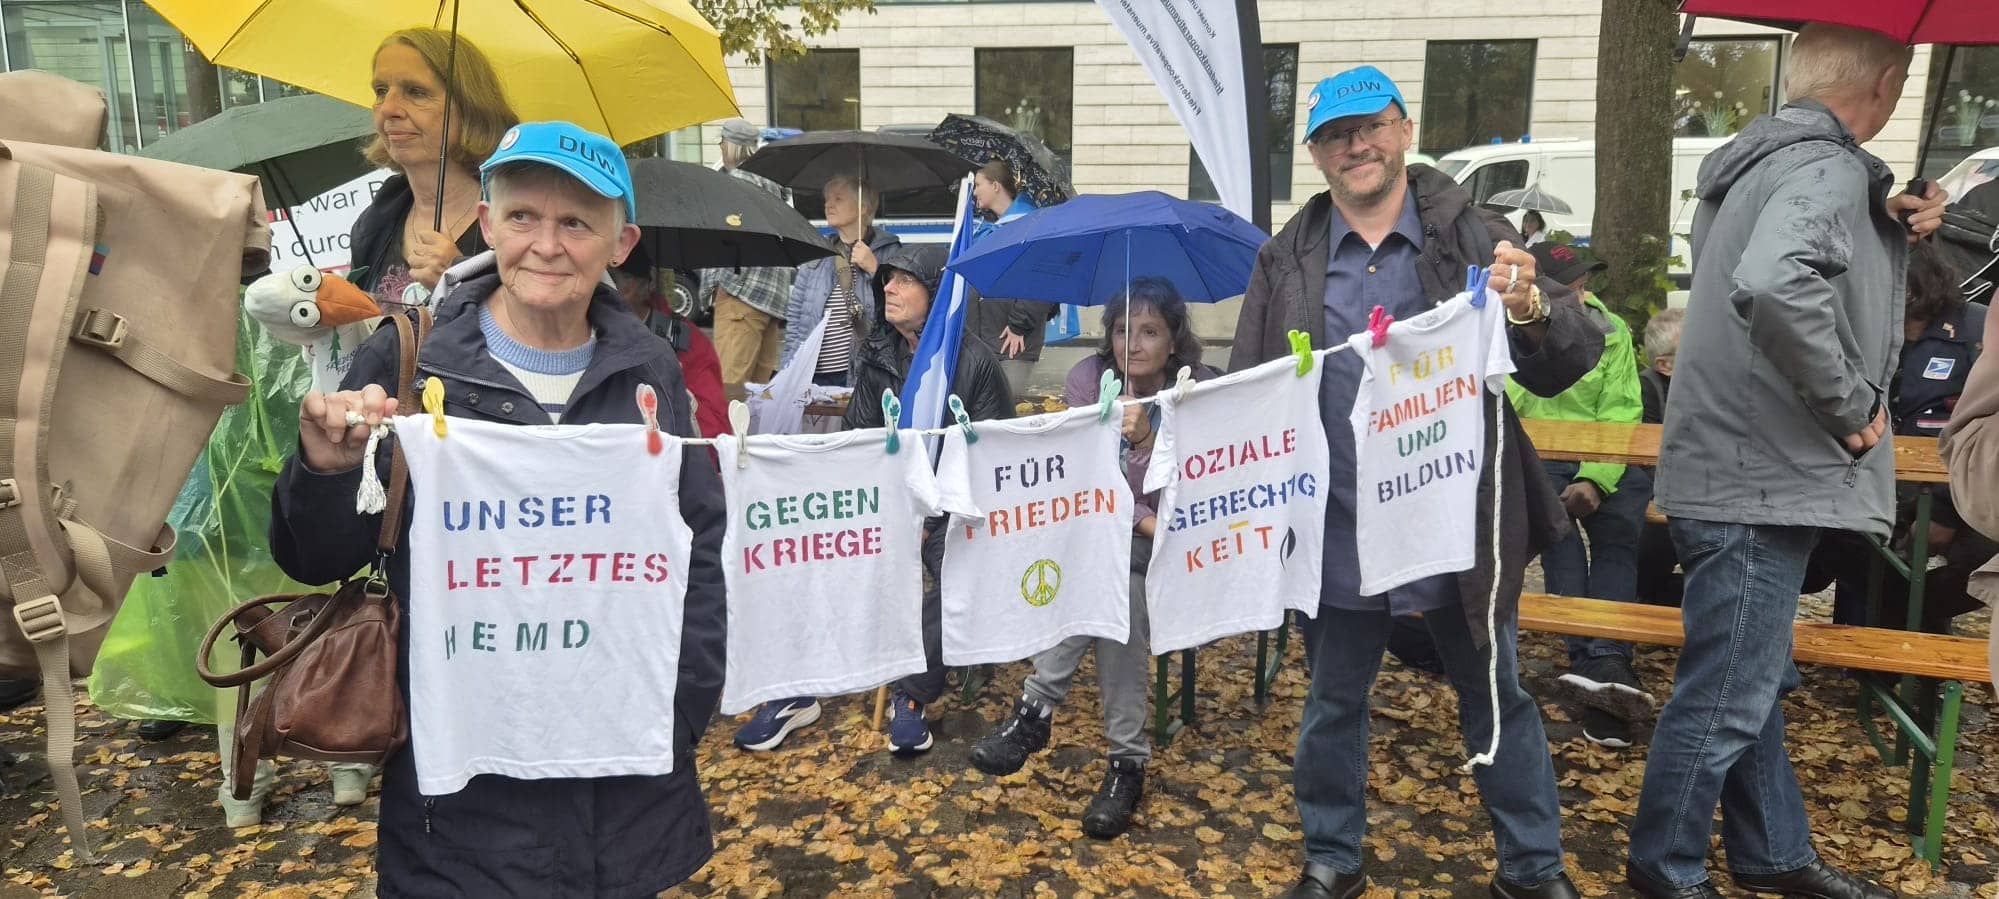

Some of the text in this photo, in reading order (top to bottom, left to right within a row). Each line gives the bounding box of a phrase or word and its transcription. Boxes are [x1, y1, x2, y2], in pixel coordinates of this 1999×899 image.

[1337, 81, 1380, 98] DUW
[560, 135, 615, 177] DUW
[308, 189, 359, 213] war
[1389, 345, 1454, 385] FÜR
[1177, 428, 1296, 482] OZIALE
[1397, 420, 1446, 457] UND
[995, 454, 1065, 492] FÜR
[1377, 450, 1475, 504] BILDUN
[443, 494, 612, 531] UNSER
[746, 486, 879, 530] GEGEN
[744, 527, 882, 573] KRIEGE
[1186, 526, 1273, 573] KEIT
[447, 552, 669, 590] LETZTES
[445, 619, 590, 660] HEMD
